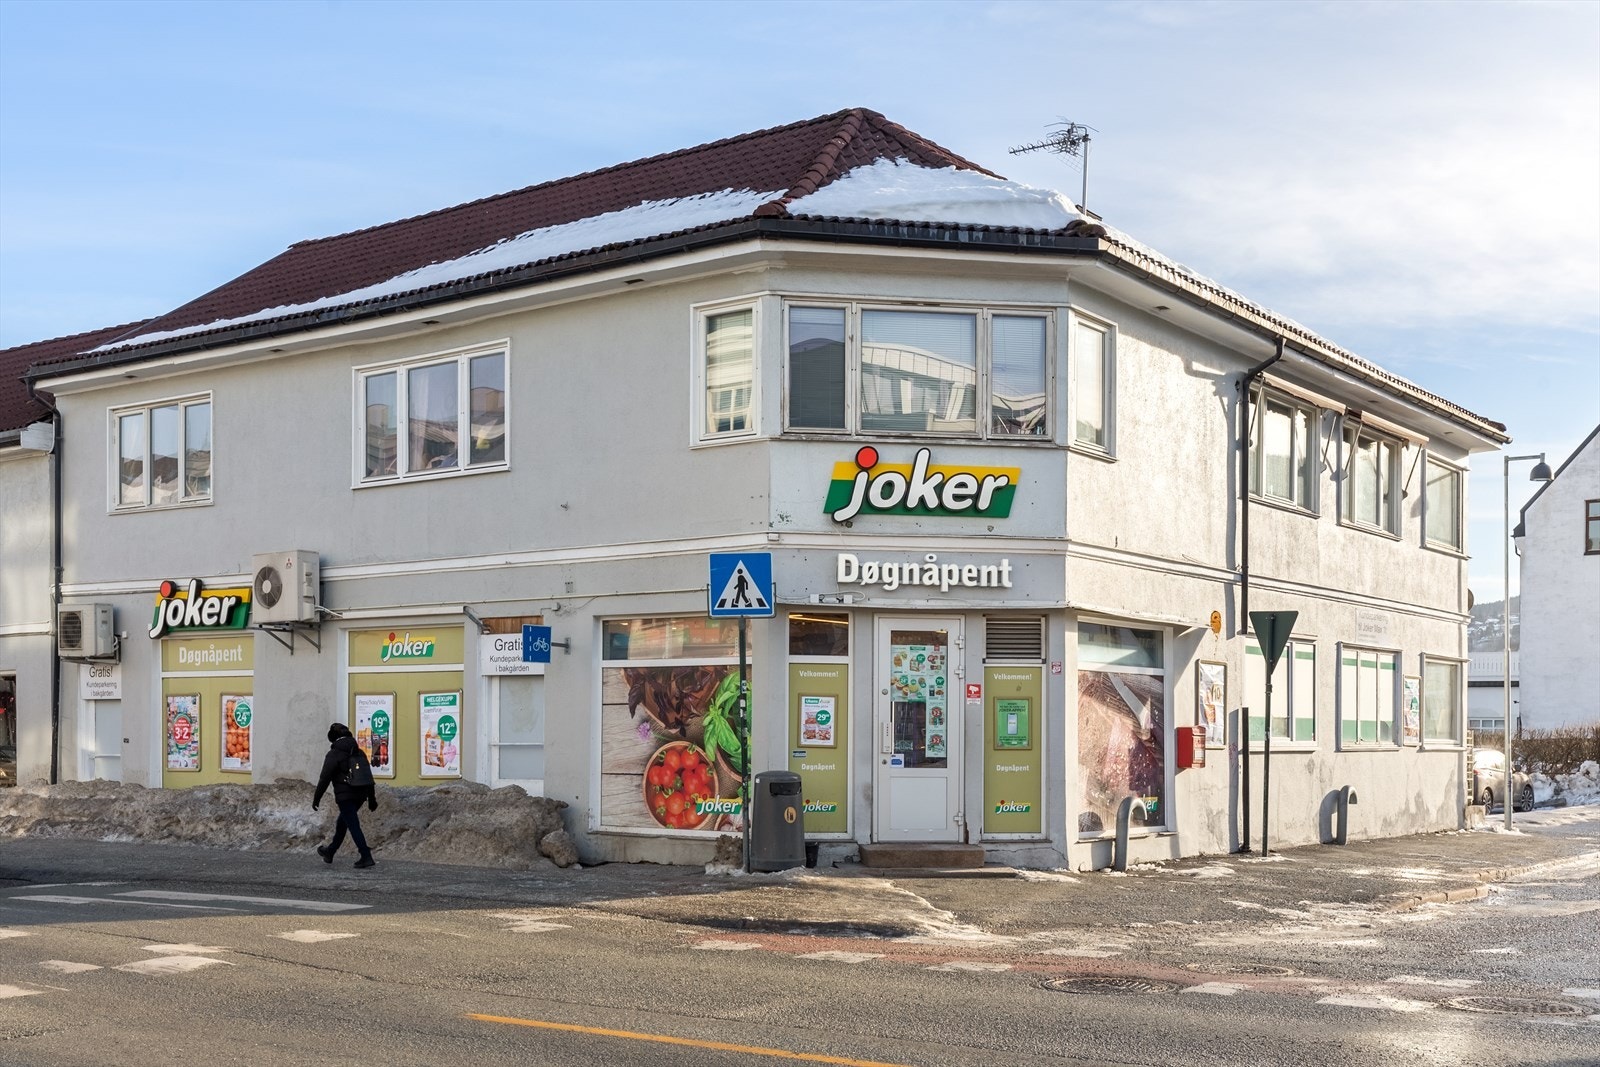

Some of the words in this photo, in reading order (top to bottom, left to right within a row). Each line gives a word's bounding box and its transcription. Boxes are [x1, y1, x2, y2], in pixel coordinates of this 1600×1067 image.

[832, 446, 1010, 522] joker
[837, 553, 1013, 592] Døgnåpent
[149, 578, 238, 639] joker
[382, 631, 432, 663] joker
[179, 644, 243, 666] Døgnåpent
[88, 665, 113, 678] Gratis!
[499, 665, 529, 673] bakgården
[799, 670, 839, 678] Velkommen!
[86, 681, 117, 690] Kundeparkering
[801, 763, 836, 771] Døgnåpent
[996, 764, 1030, 772] Døgnåpent
[696, 793, 739, 816] joker
[803, 799, 835, 814] joker
[996, 799, 1030, 814] joker
